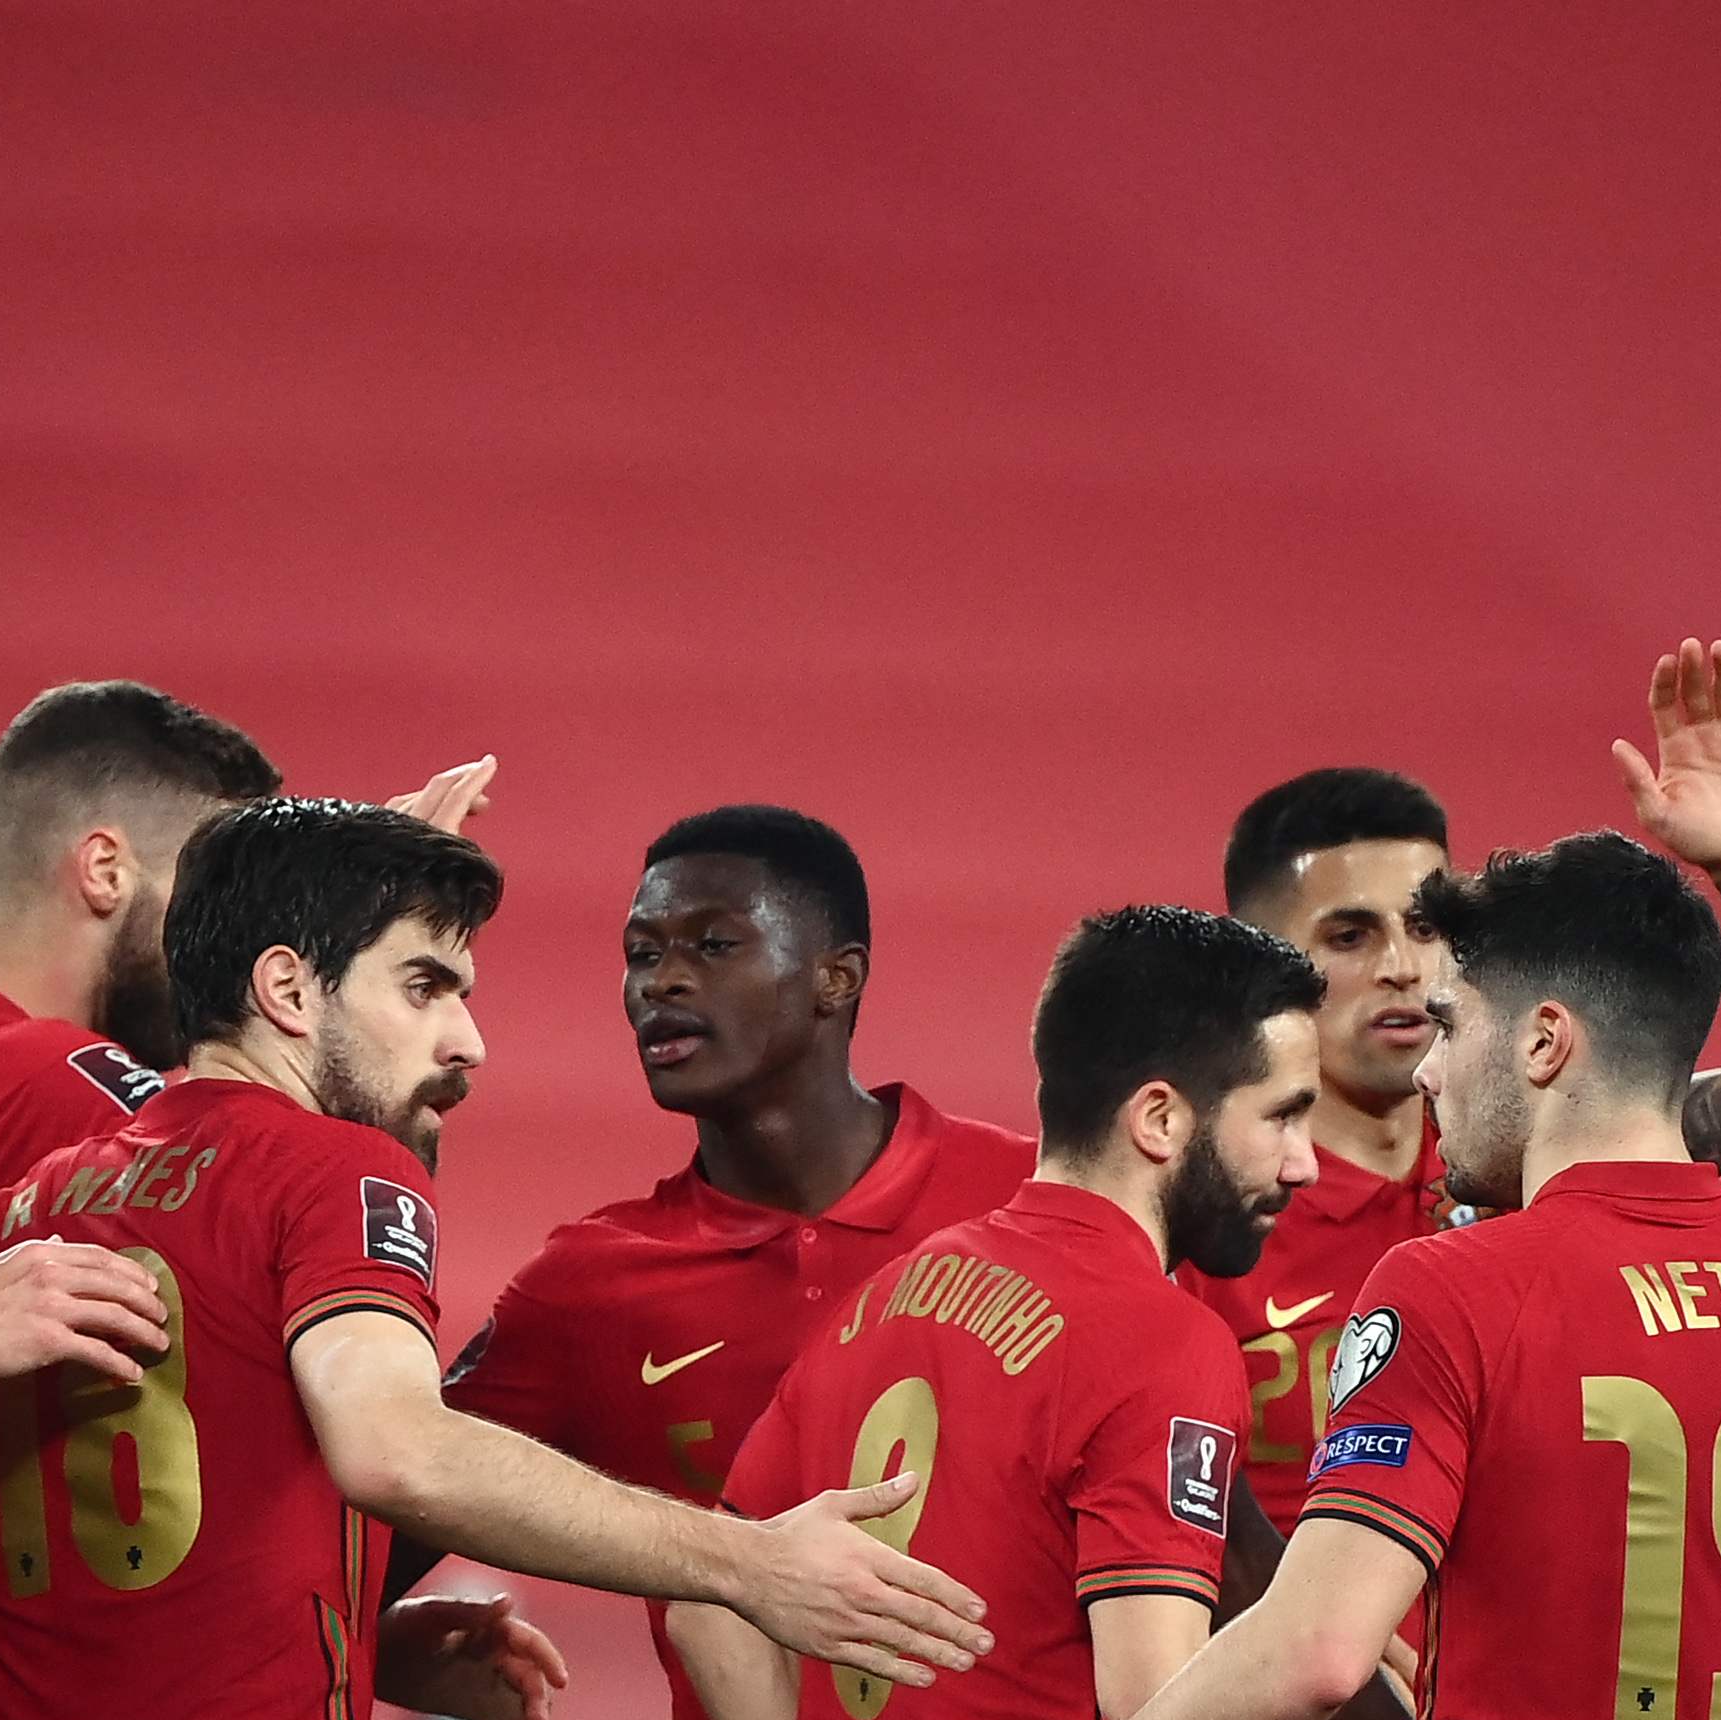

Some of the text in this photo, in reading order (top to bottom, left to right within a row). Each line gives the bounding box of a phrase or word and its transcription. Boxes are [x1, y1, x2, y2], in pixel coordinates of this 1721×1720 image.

[839, 1253, 1064, 1376] J MOUTINHO
[1327, 1435, 1408, 1461] RESPECT
